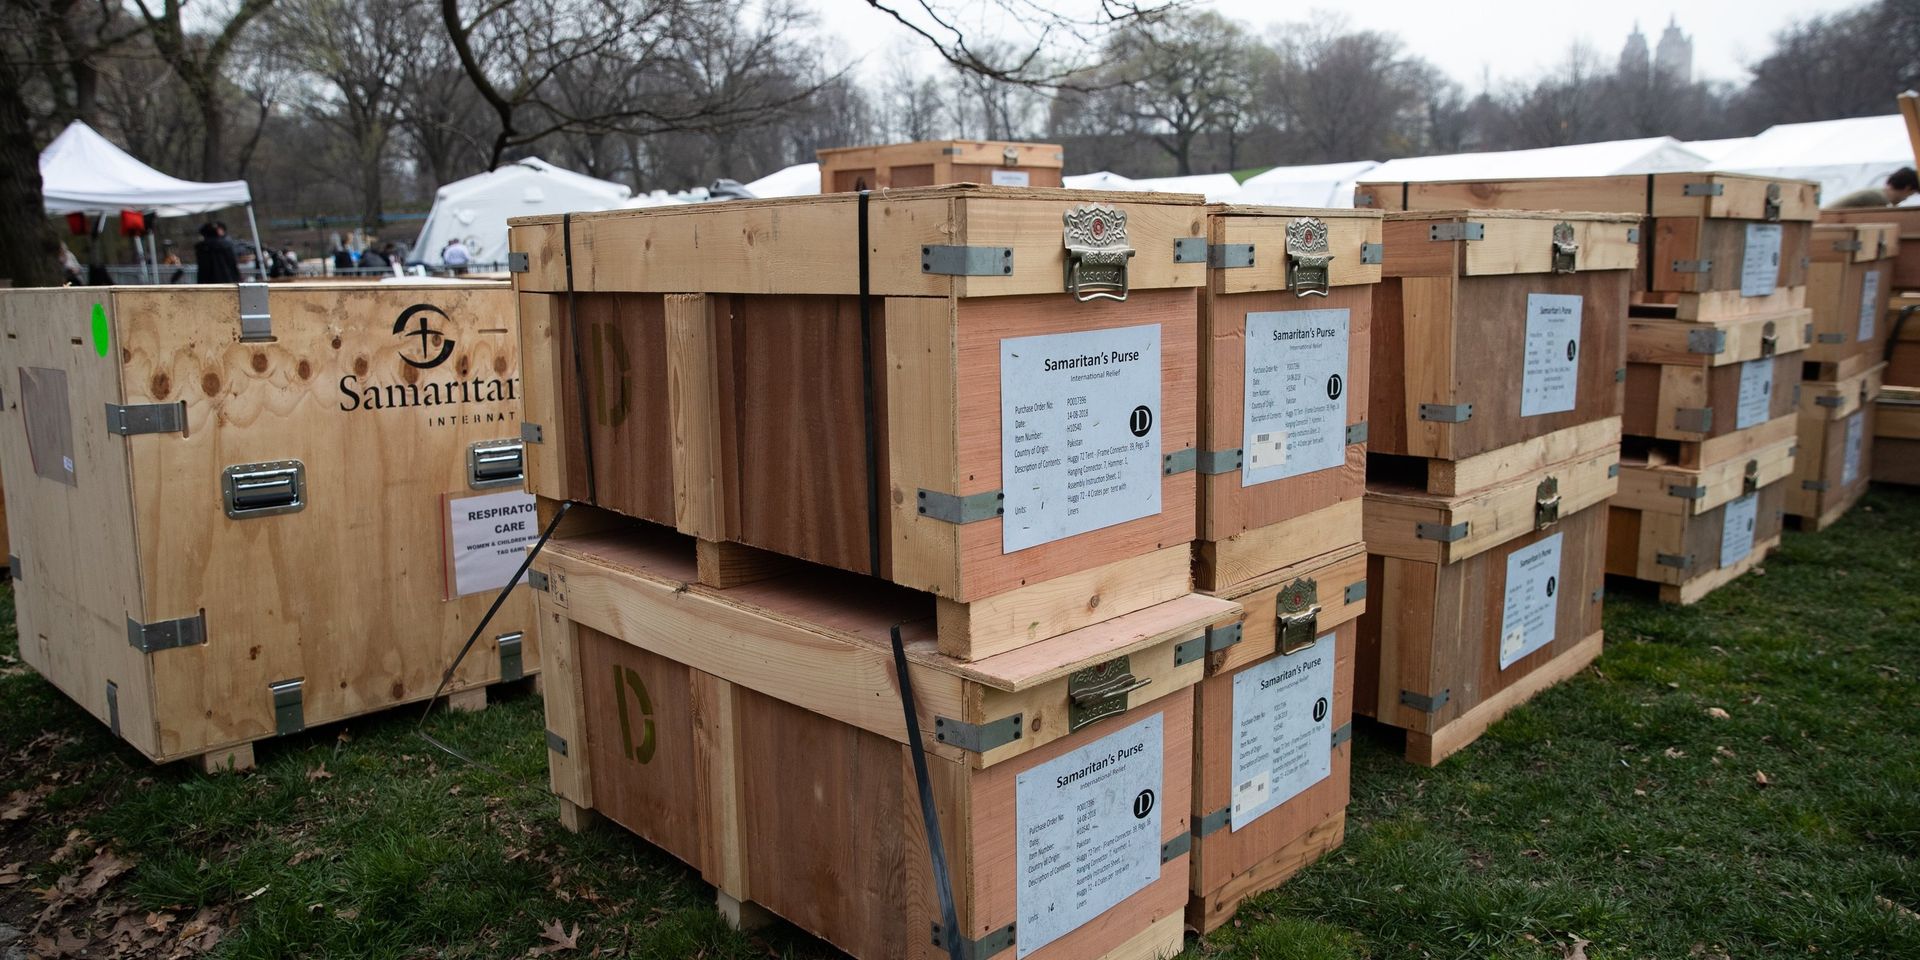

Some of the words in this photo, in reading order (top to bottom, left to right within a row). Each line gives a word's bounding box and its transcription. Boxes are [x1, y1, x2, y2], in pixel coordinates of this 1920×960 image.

[1273, 328, 1314, 341] Samaritan's
[1316, 327, 1336, 338] Purse
[1044, 352, 1108, 372] Samaritan's
[1111, 350, 1139, 364] Purse
[592, 323, 632, 428] D
[1071, 370, 1105, 382] International
[1106, 369, 1120, 378] Relief
[1015, 404, 1033, 414] Purchase
[1034, 402, 1045, 411] Order
[1014, 448, 1029, 457] Country
[1031, 445, 1035, 454] of
[1067, 438, 1082, 447] Pakistan
[1014, 462, 1037, 472] Description
[1038, 460, 1042, 469] of
[1068, 479, 1084, 489] Assembly
[1086, 474, 1104, 486] Instruction
[468, 503, 537, 521] RESPIRATO
[494, 521, 526, 534] CARE
[467, 542, 490, 551] WOMEN
[497, 537, 527, 546] CHILDREN
[1260, 665, 1301, 690] Samaritan's
[1302, 657, 1322, 672] Purse
[613, 664, 656, 765] D
[1056, 753, 1115, 788] Samaritan's
[1117, 742, 1144, 762] Purse
[1080, 771, 1111, 790] International
[1112, 764, 1126, 776] Relief
